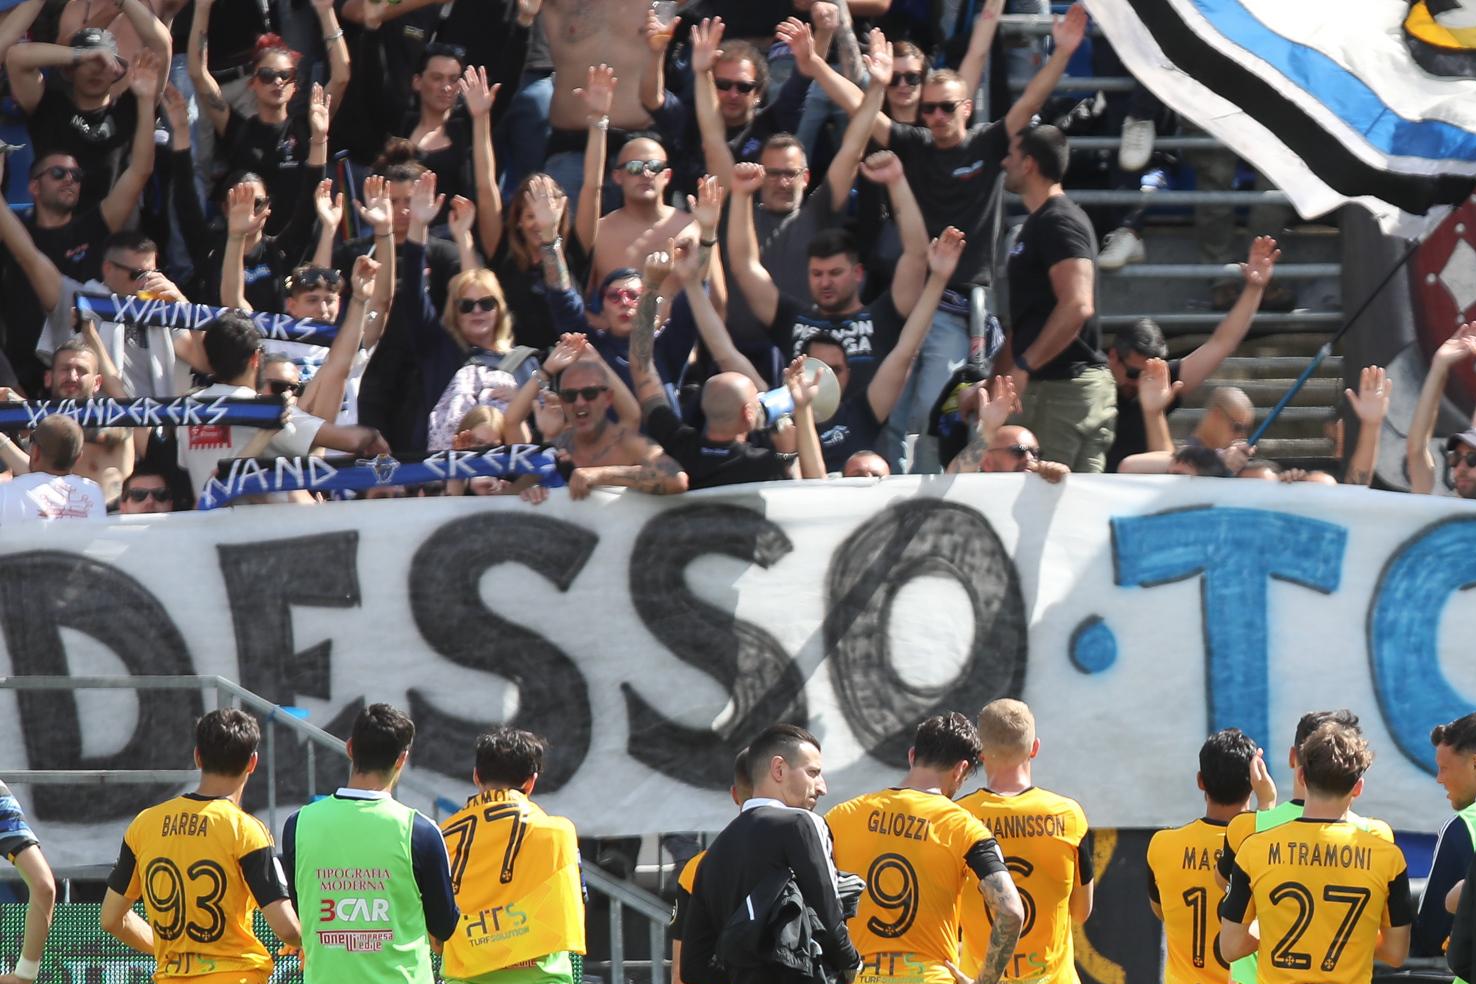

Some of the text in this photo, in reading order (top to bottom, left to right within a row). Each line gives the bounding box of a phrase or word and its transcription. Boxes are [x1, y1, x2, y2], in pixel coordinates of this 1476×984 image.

[111, 293, 317, 340] WANDERS
[162, 811, 208, 837] BARBA
[867, 810, 930, 842] GLIOZZI
[441, 803, 529, 895] 77
[1182, 846, 1224, 871] MAS
[316, 868, 391, 881] TIPOGRAFIA
[320, 879, 385, 891] MODERNA
[145, 856, 228, 943] 93
[320, 898, 390, 922] 3CAR
[867, 852, 919, 939] 9
[1269, 881, 1372, 972] 27
